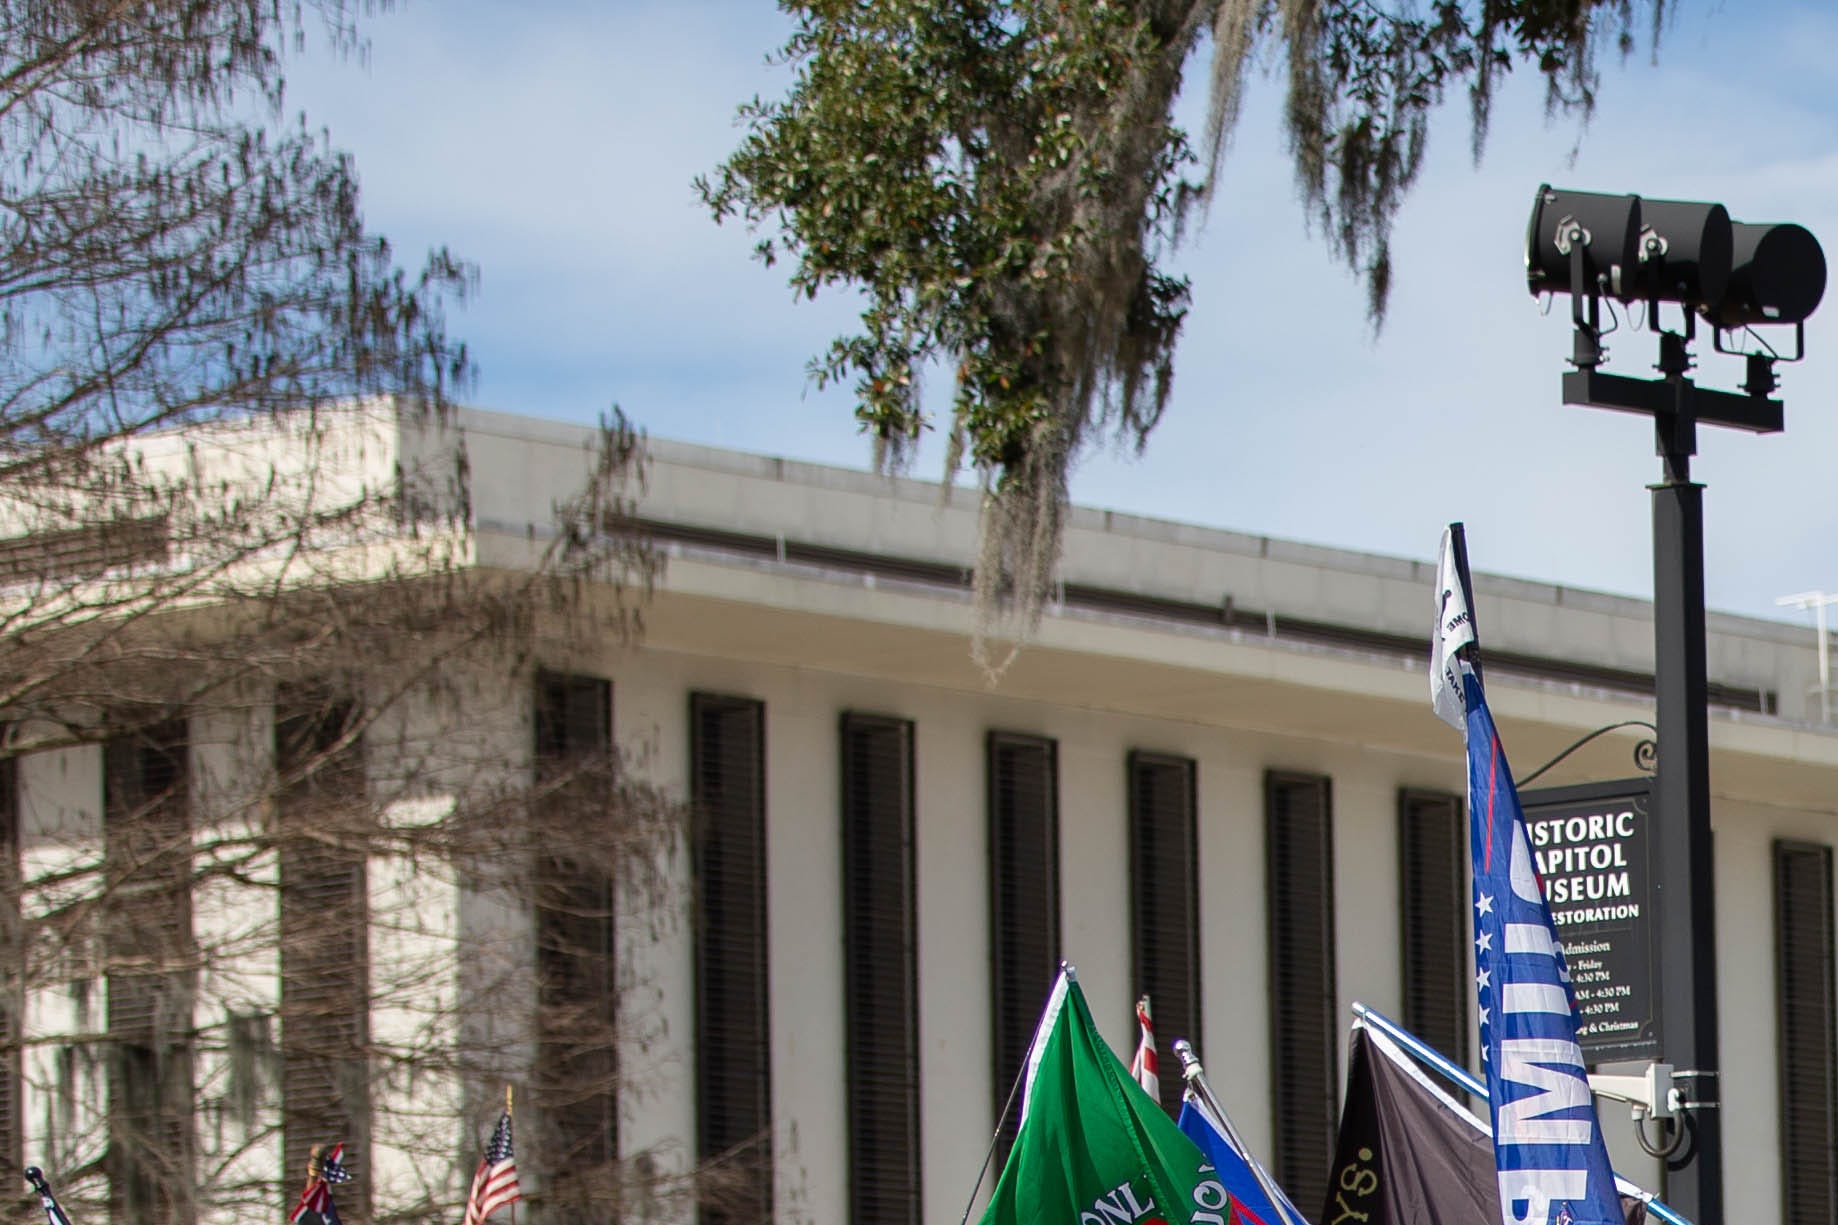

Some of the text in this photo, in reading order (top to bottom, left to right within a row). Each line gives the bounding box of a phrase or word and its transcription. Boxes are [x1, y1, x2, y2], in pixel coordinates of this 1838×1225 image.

[1525, 811, 1635, 847] ISTORIC
[1535, 843, 1628, 875] APITOL
[1545, 872, 1631, 904] SEUM
[1551, 904, 1640, 926] ESTORATION
[1595, 970, 1610, 981] PM
[1597, 987, 1614, 998] 4:30
[1616, 985, 1631, 997] PM
[1585, 1003, 1603, 1015] 4:30
[1605, 1002, 1619, 1012] PM
